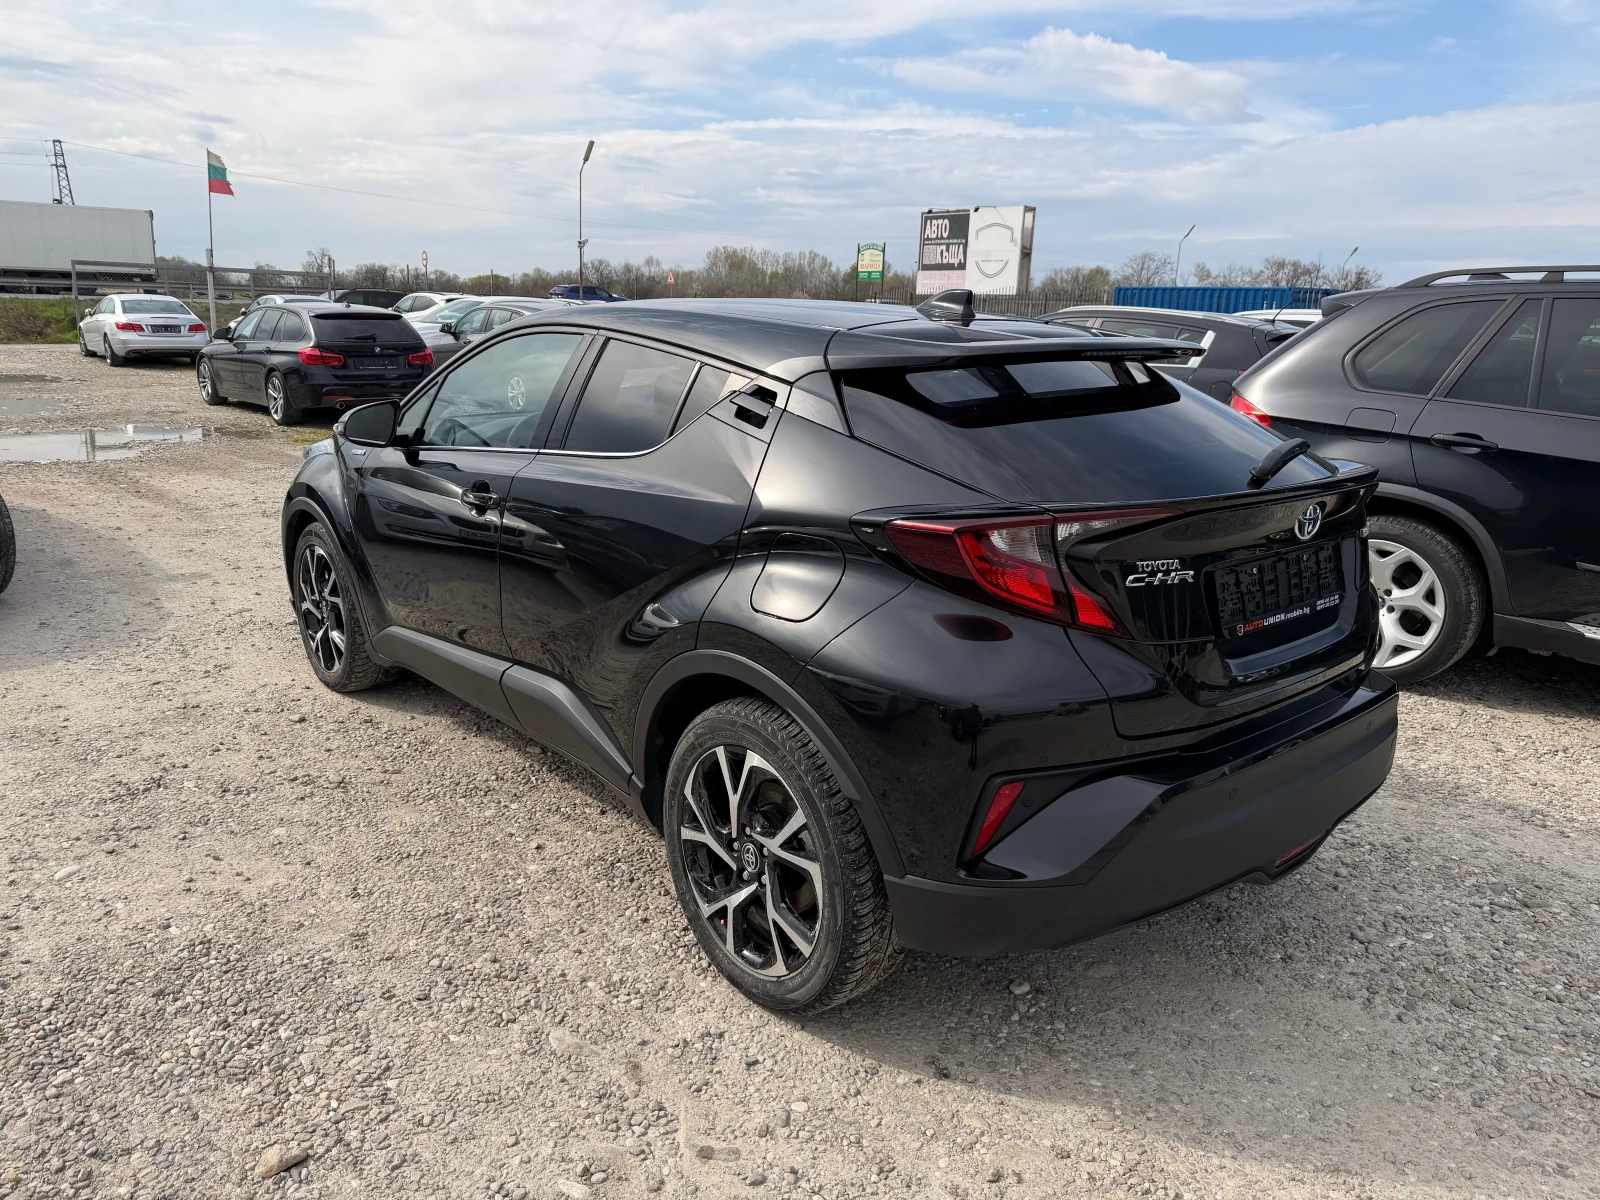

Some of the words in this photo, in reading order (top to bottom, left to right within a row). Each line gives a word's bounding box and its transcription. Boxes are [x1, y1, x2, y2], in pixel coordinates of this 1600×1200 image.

[924, 218, 950, 239] АВТО
[936, 244, 964, 268] КЪЩА
[1136, 559, 1181, 572] TOYOTA
[1125, 570, 1195, 587] C-HR
